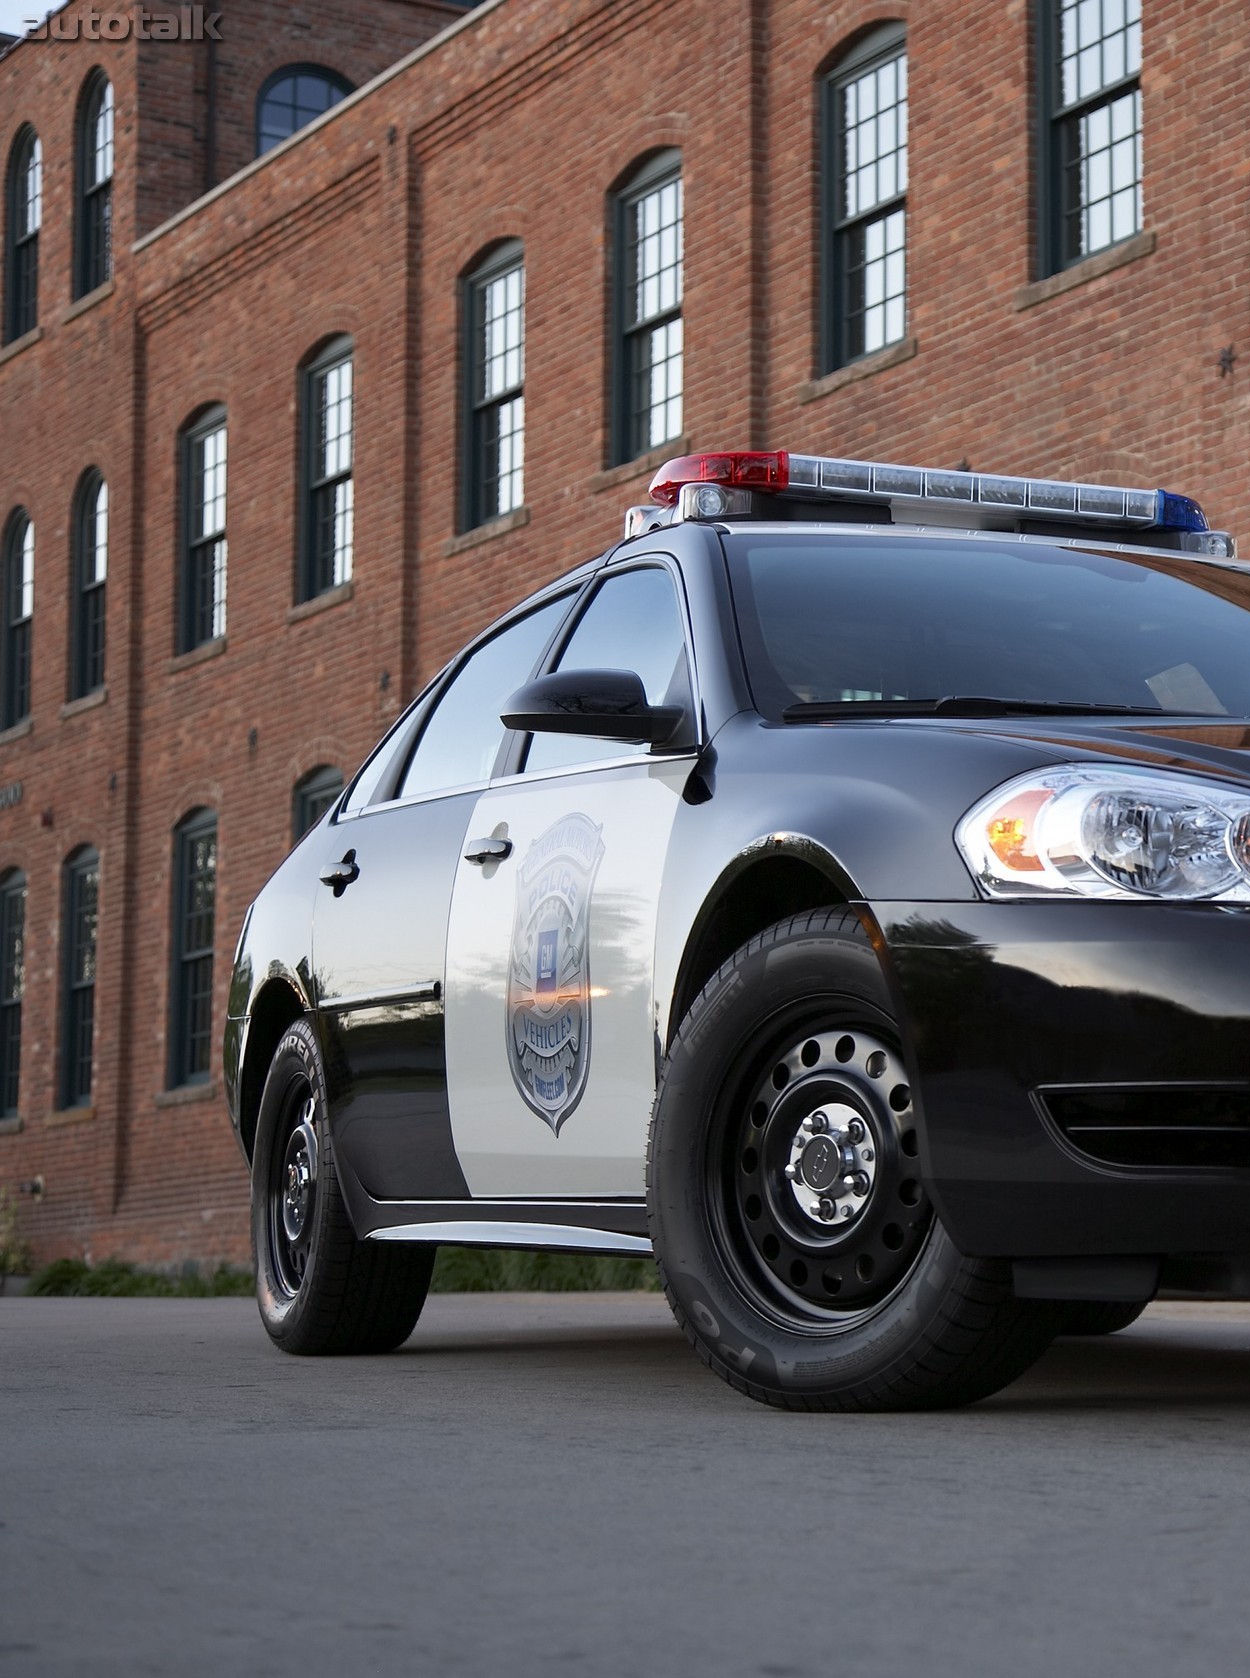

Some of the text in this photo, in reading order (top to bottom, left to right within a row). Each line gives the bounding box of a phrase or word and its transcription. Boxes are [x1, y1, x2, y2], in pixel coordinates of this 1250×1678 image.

[529, 868, 577, 913] POLICE
[541, 944, 553, 971] GM
[523, 1008, 572, 1049] VEHICLES
